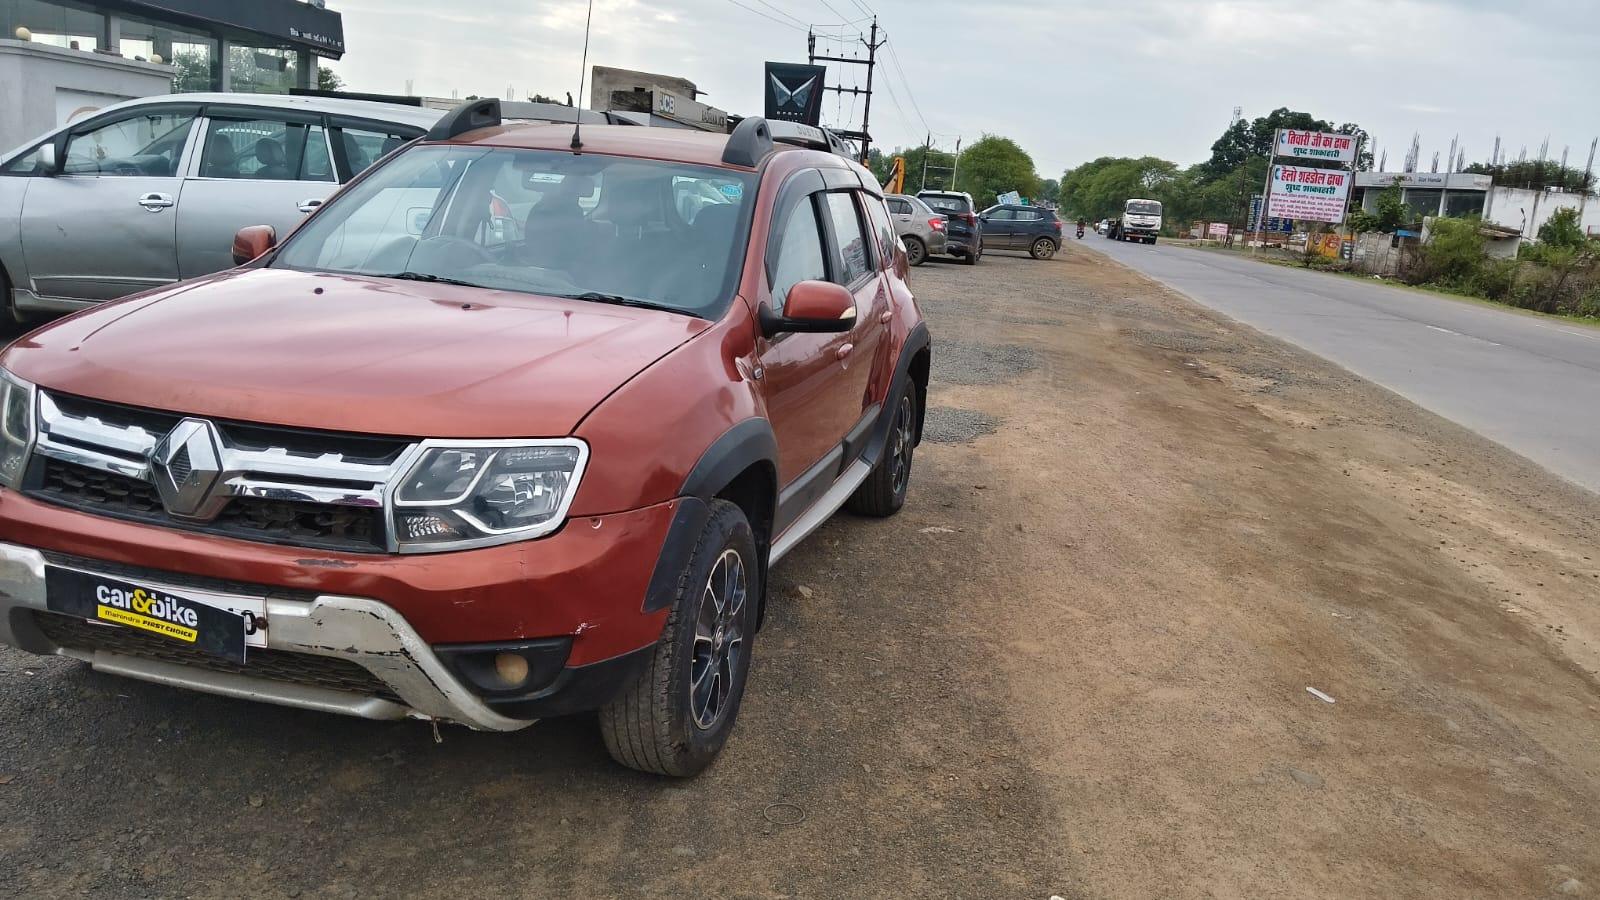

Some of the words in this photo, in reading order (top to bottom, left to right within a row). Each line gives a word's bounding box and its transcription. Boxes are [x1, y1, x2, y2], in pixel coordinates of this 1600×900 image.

[660, 93, 675, 114] JCB
[1288, 130, 1310, 146] तिवारी
[1311, 132, 1322, 148] जी
[1322, 137, 1333, 149] का
[1334, 137, 1351, 150] ढाबा
[1327, 173, 1344, 186] ढाबा
[96, 585, 198, 627] car&bike
[142, 619, 164, 632] FIRST
[165, 626, 193, 638] CHOICE
